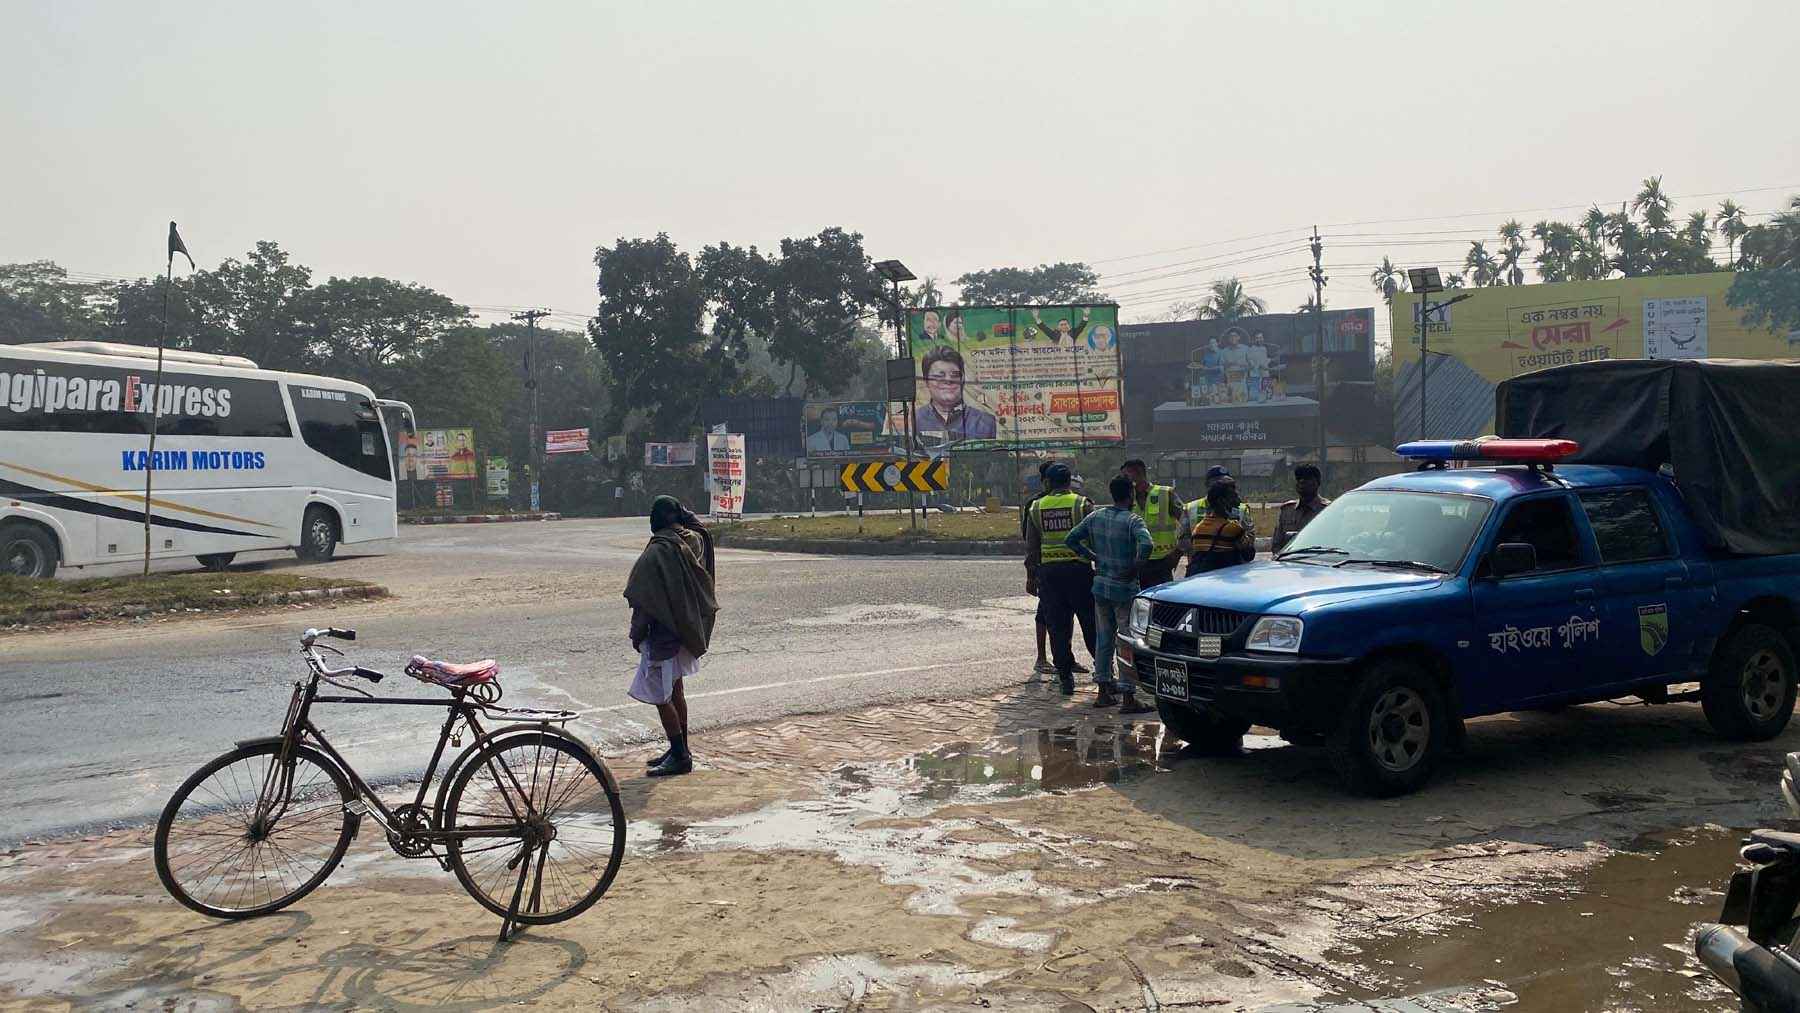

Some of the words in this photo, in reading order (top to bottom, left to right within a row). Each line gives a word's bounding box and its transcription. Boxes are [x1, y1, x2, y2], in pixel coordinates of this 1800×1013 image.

[1521, 311, 1545, 323] এক
[1548, 307, 1579, 321] নম্বর
[1531, 322, 1592, 351] সেরা
[124, 375, 231, 418] Express
[122, 450, 188, 471] KARIM
[192, 450, 266, 470] MOTORS
[1043, 519, 1072, 530] POLICE
[1488, 624, 1552, 653] হাইওয়ে
[1558, 616, 1600, 649] পুলিশ
